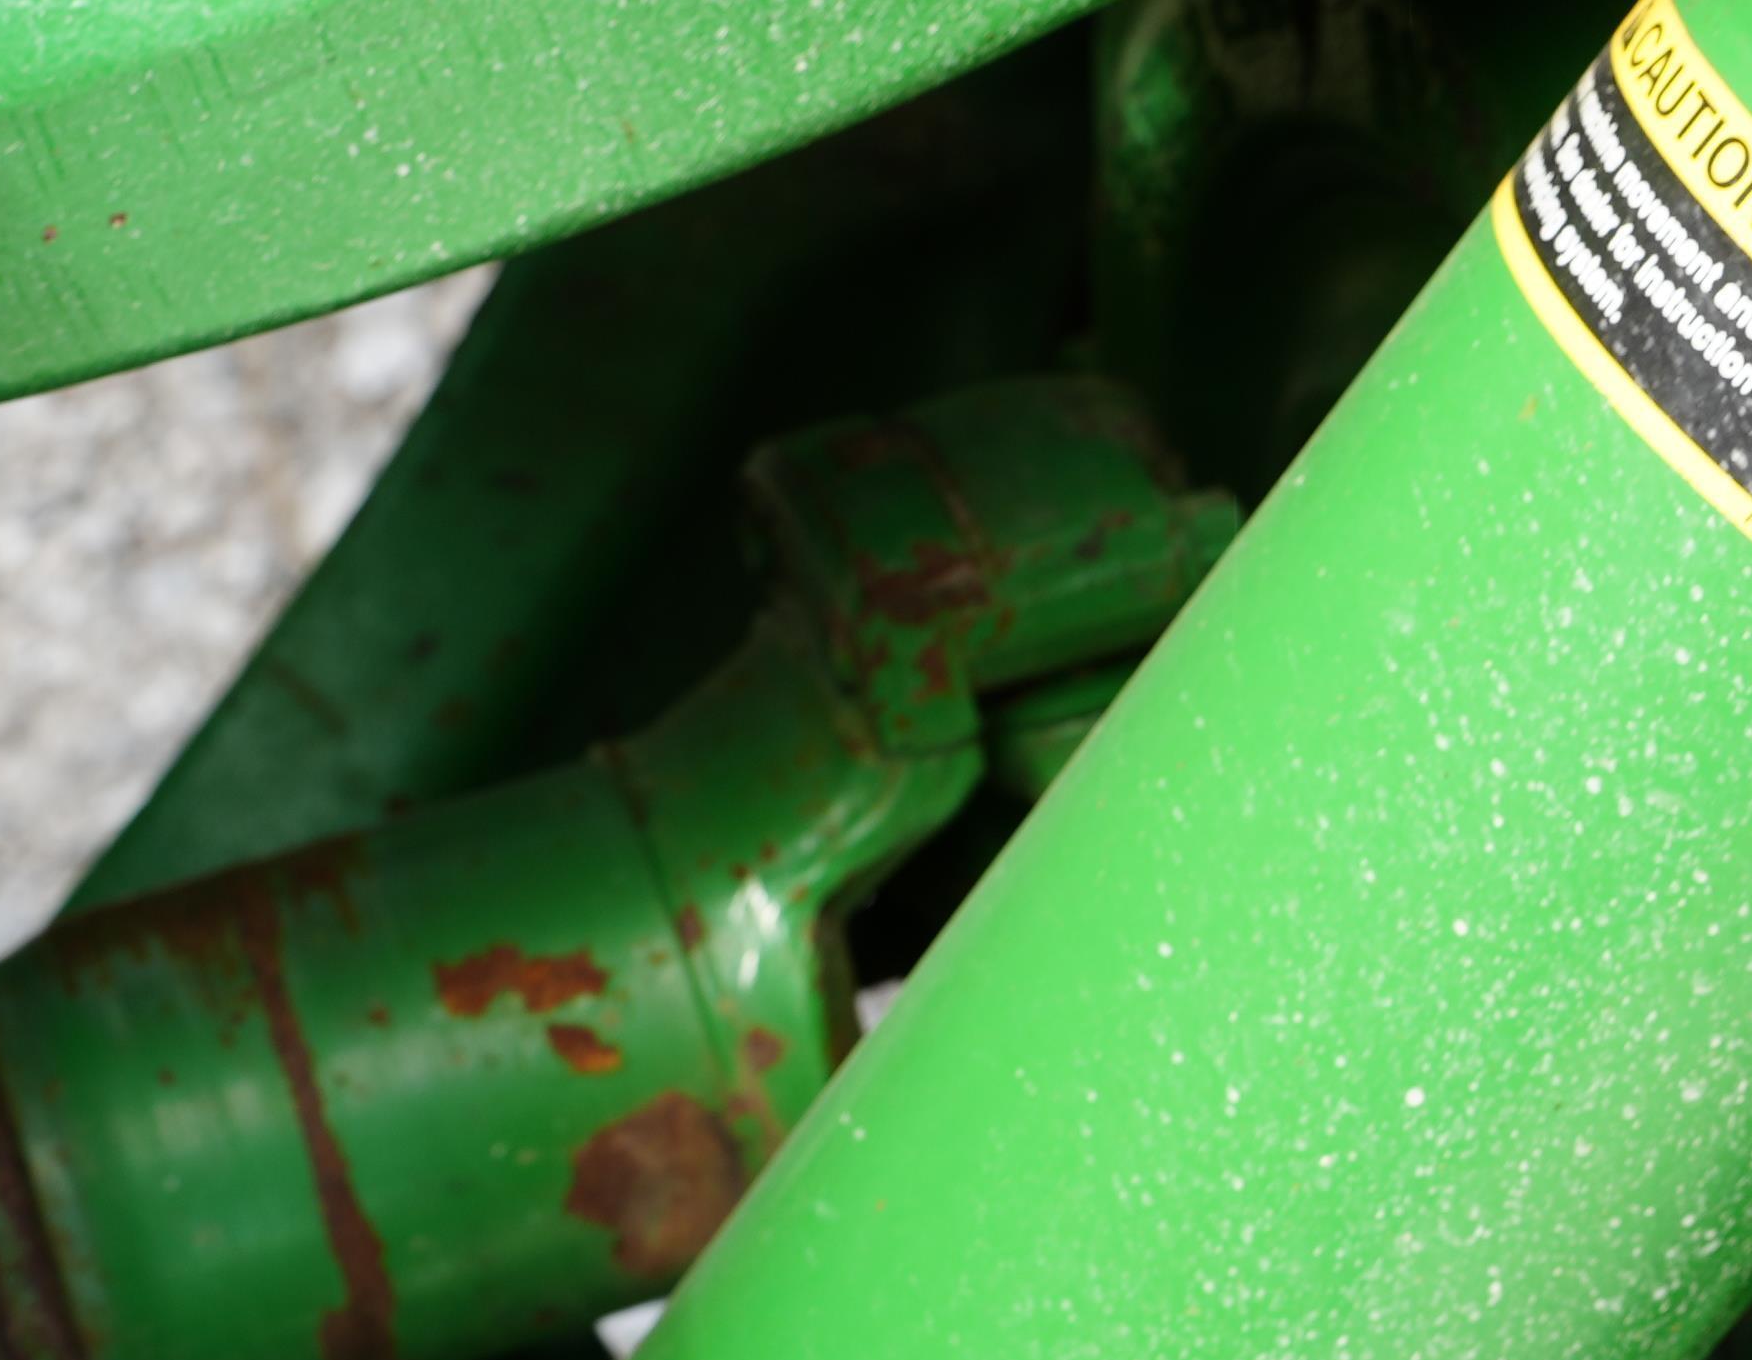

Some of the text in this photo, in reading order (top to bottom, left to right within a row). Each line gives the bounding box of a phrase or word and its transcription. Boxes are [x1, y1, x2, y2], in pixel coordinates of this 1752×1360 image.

[1553, 223, 1625, 325] system.
[1606, 222, 1646, 270] for
[1612, 160, 1725, 293] movement
